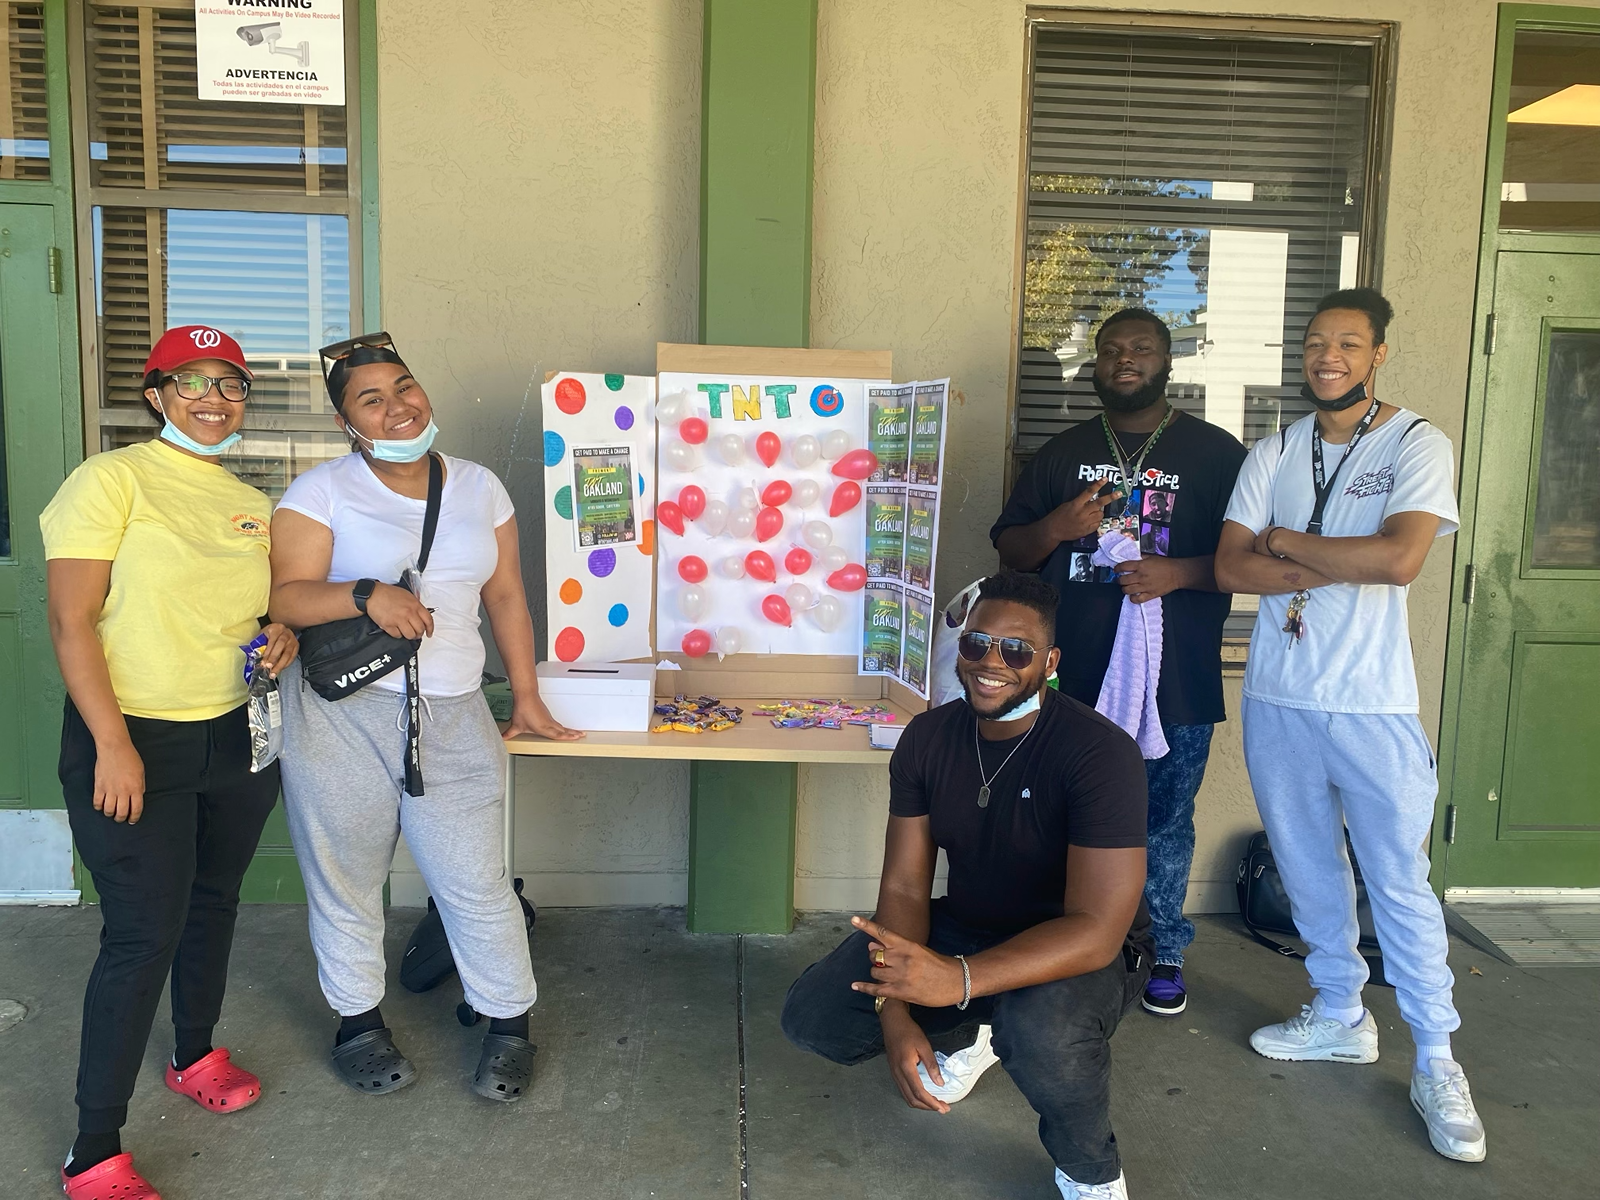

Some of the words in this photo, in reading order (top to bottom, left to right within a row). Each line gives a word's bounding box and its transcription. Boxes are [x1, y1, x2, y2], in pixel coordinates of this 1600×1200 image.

[246, 10, 270, 18] Campus
[272, 11, 284, 19] May
[312, 12, 340, 20] Recorded
[225, 69, 318, 81] ADVERTENCIA
[222, 89, 247, 97] pueden
[261, 90, 292, 98] grabadas
[190, 330, 220, 348] W
[698, 384, 797, 421] TNT
[877, 421, 907, 436] OAKLAND
[916, 421, 937, 435] OAKLAND
[583, 482, 623, 497] OAKLAND
[875, 520, 903, 532] OAKLAND
[910, 524, 930, 540] OAKLAND
[872, 614, 900, 630] OAKLAND
[334, 654, 391, 688] VICE+
